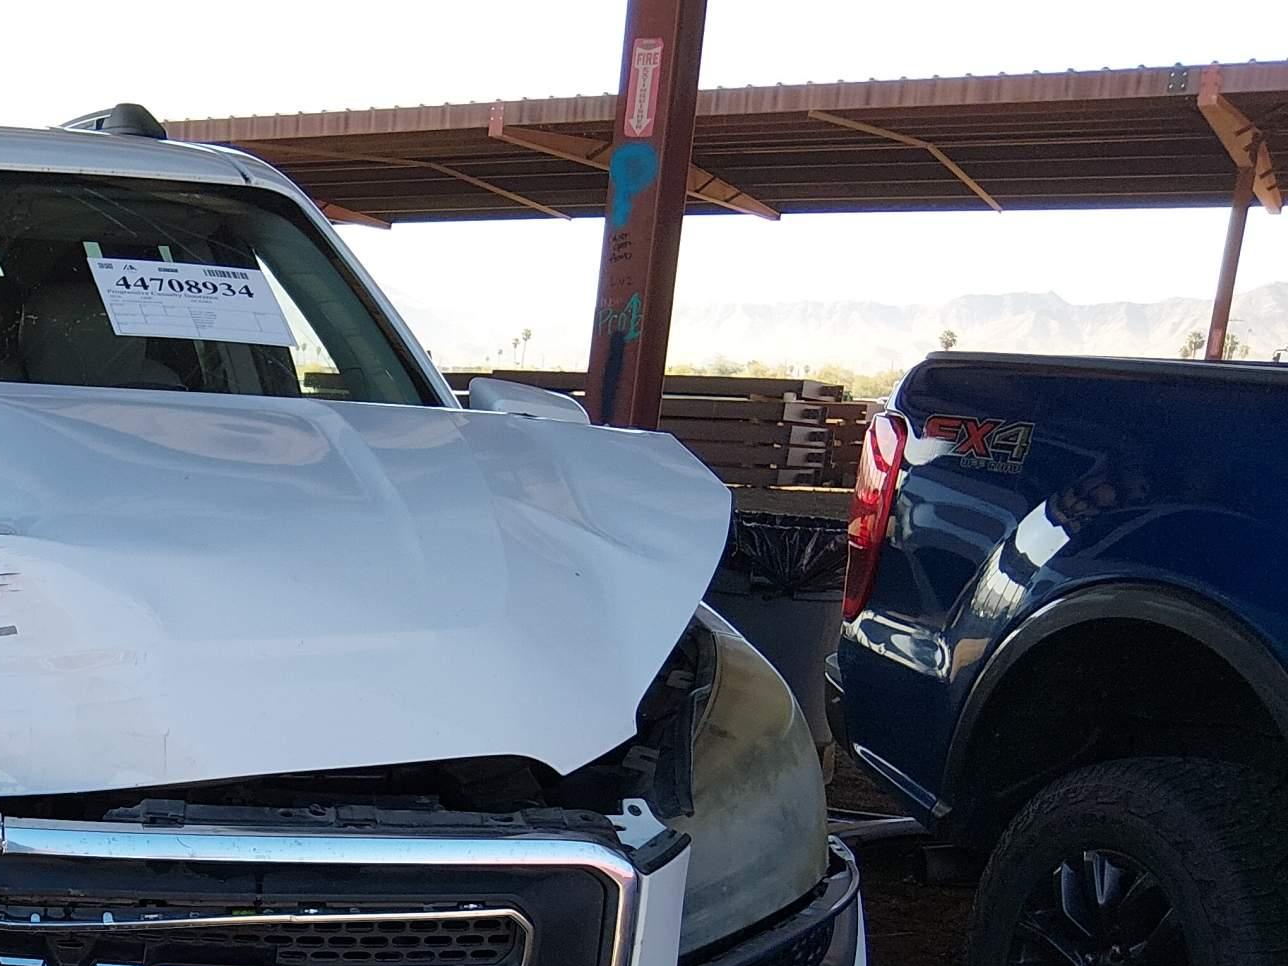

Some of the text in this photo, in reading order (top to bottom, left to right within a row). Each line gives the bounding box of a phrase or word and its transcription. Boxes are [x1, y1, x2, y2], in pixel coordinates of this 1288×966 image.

[636, 51, 660, 65] FIRE
[115, 275, 255, 299] 44708934
[923, 413, 1035, 464] FX4
